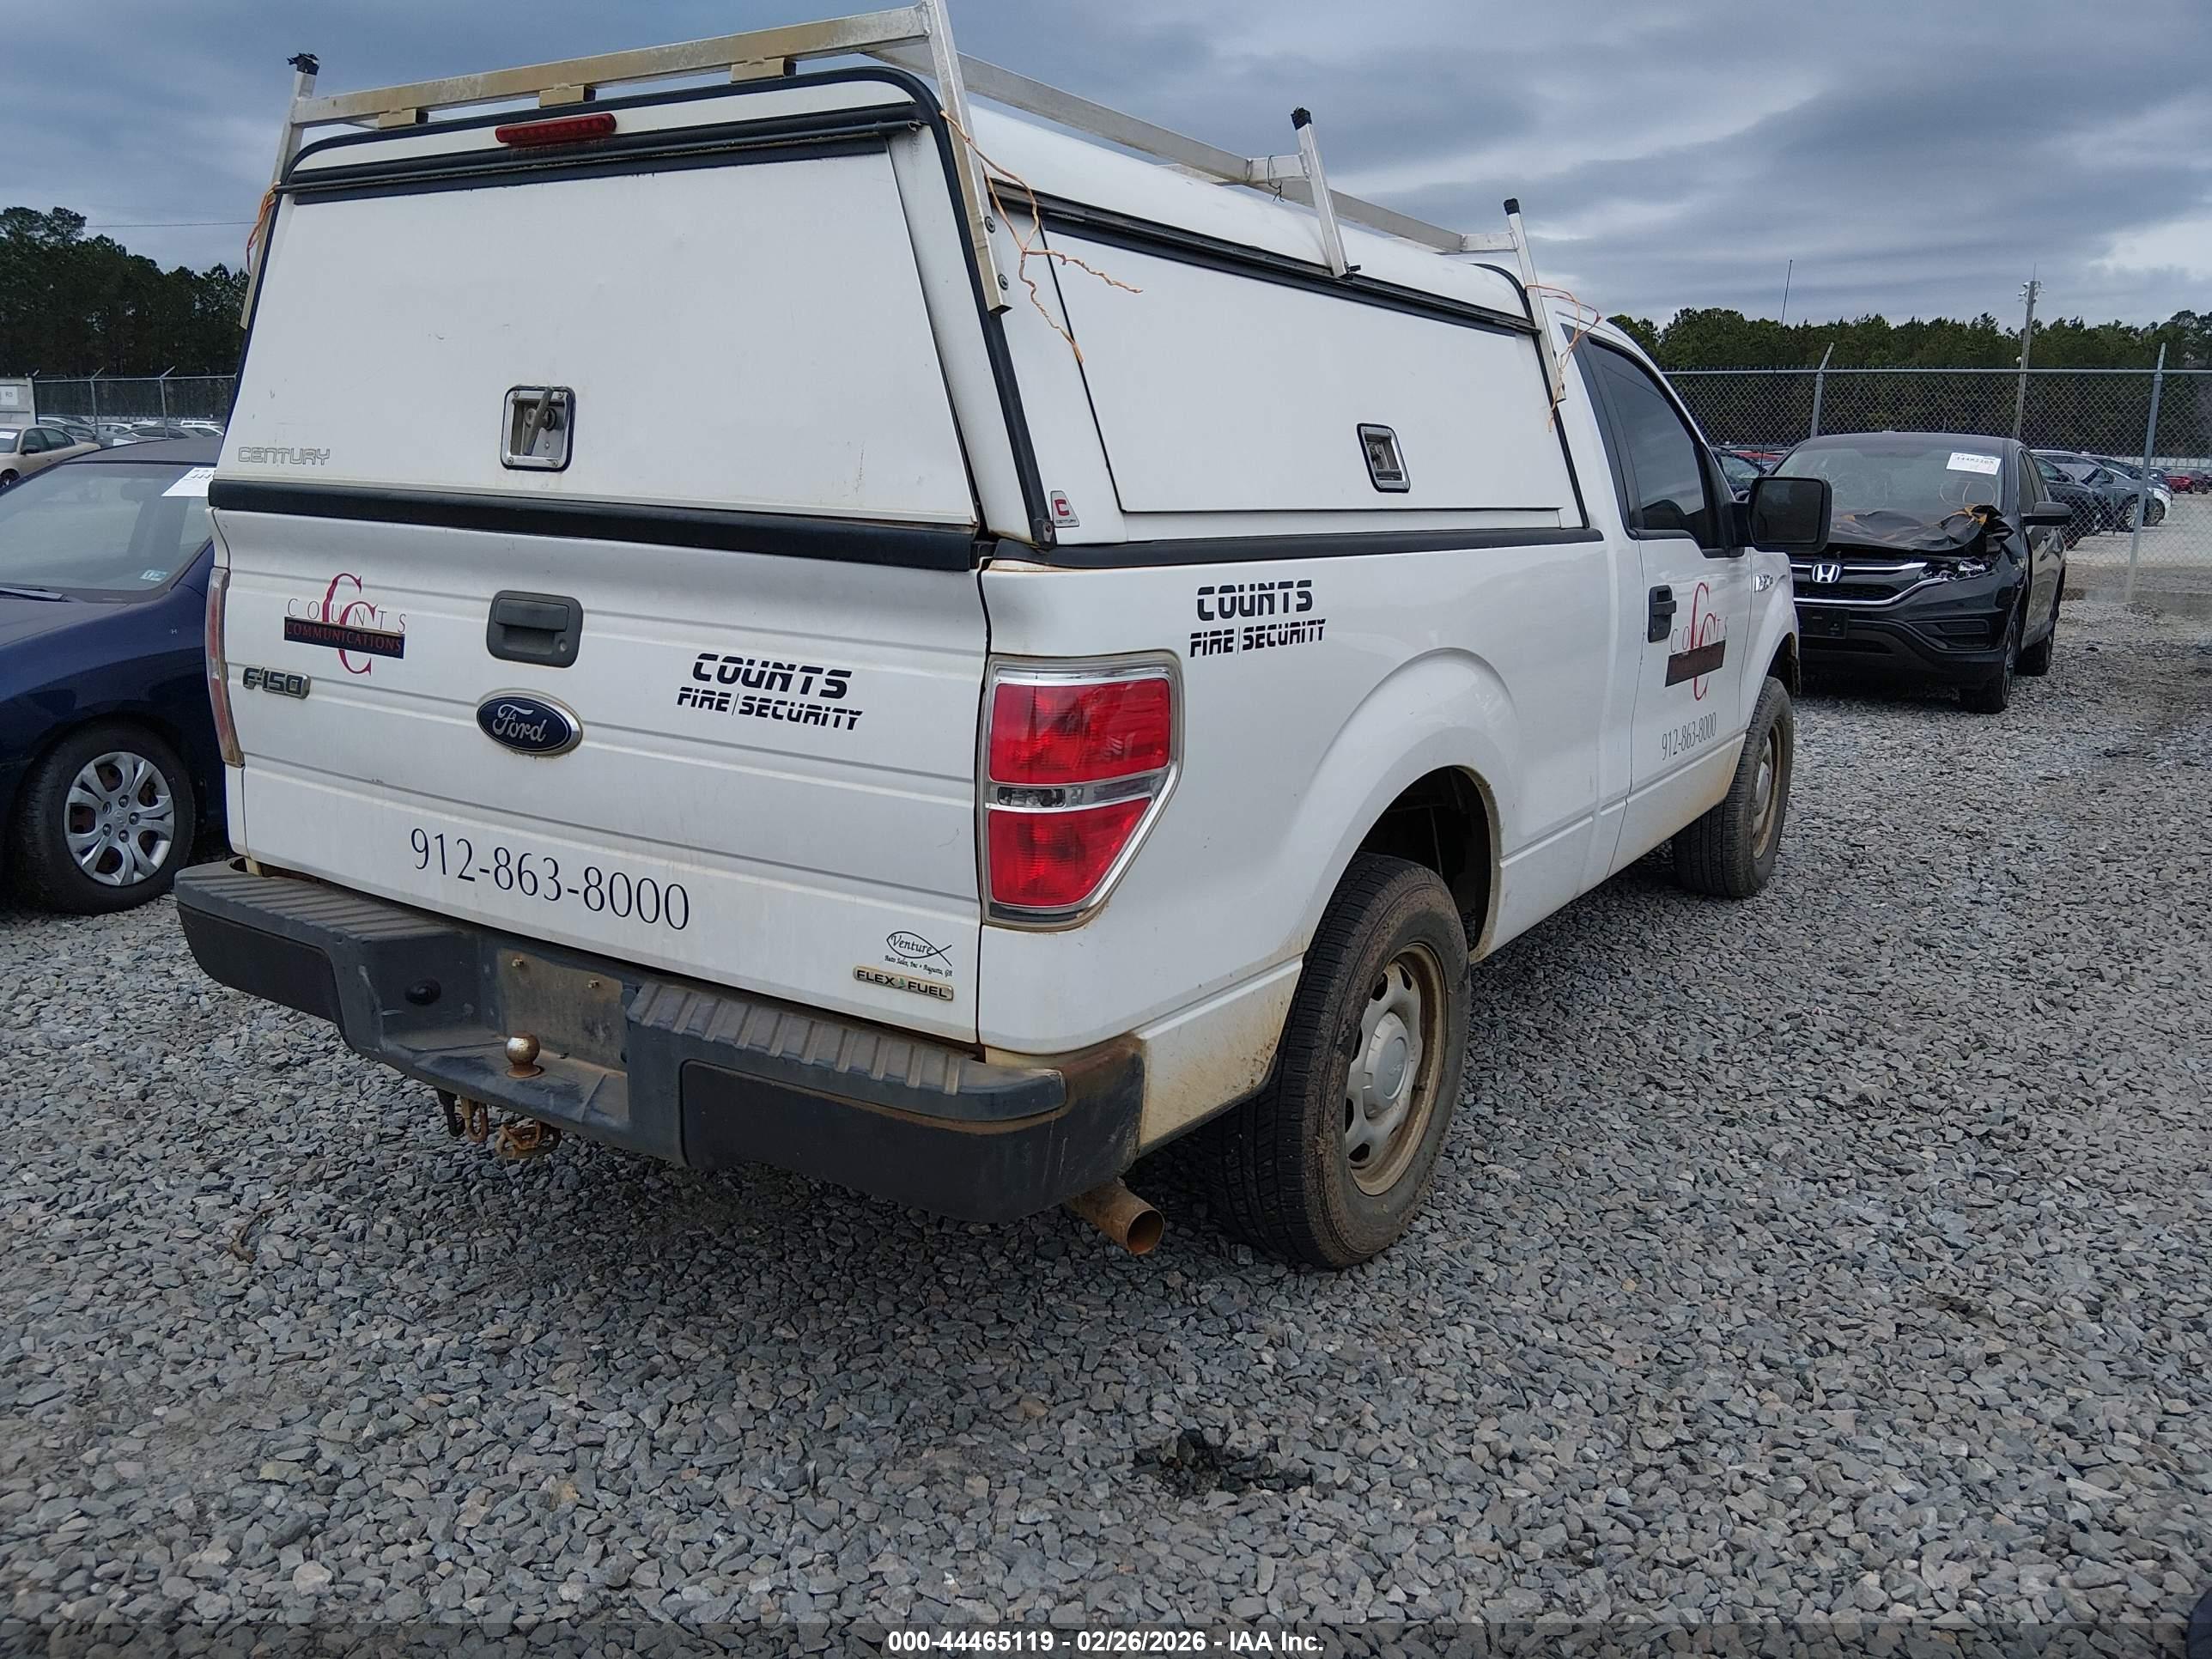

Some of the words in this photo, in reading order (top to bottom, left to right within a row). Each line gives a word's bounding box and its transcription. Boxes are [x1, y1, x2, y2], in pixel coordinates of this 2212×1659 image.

[238, 447, 331, 465] CENTURY
[287, 598, 407, 634] COUNTS
[1197, 580, 1313, 622] COUNTS
[286, 622, 402, 653] COMMUNICATIONS
[1189, 629, 1235, 658] FIRE
[1242, 618, 1327, 651] SECURITY
[242, 666, 310, 699] F-150
[692, 653, 853, 700] COUNTS
[492, 704, 549, 742] Ford
[677, 686, 732, 712] FIRE
[738, 696, 863, 731] SECURITY
[1662, 712, 1717, 761] 912-863-8000
[410, 828, 690, 930] 912-863-8000
[890, 934, 933, 955] Venture
[857, 969, 895, 987] FLEX
[908, 981, 947, 998] FUEL
